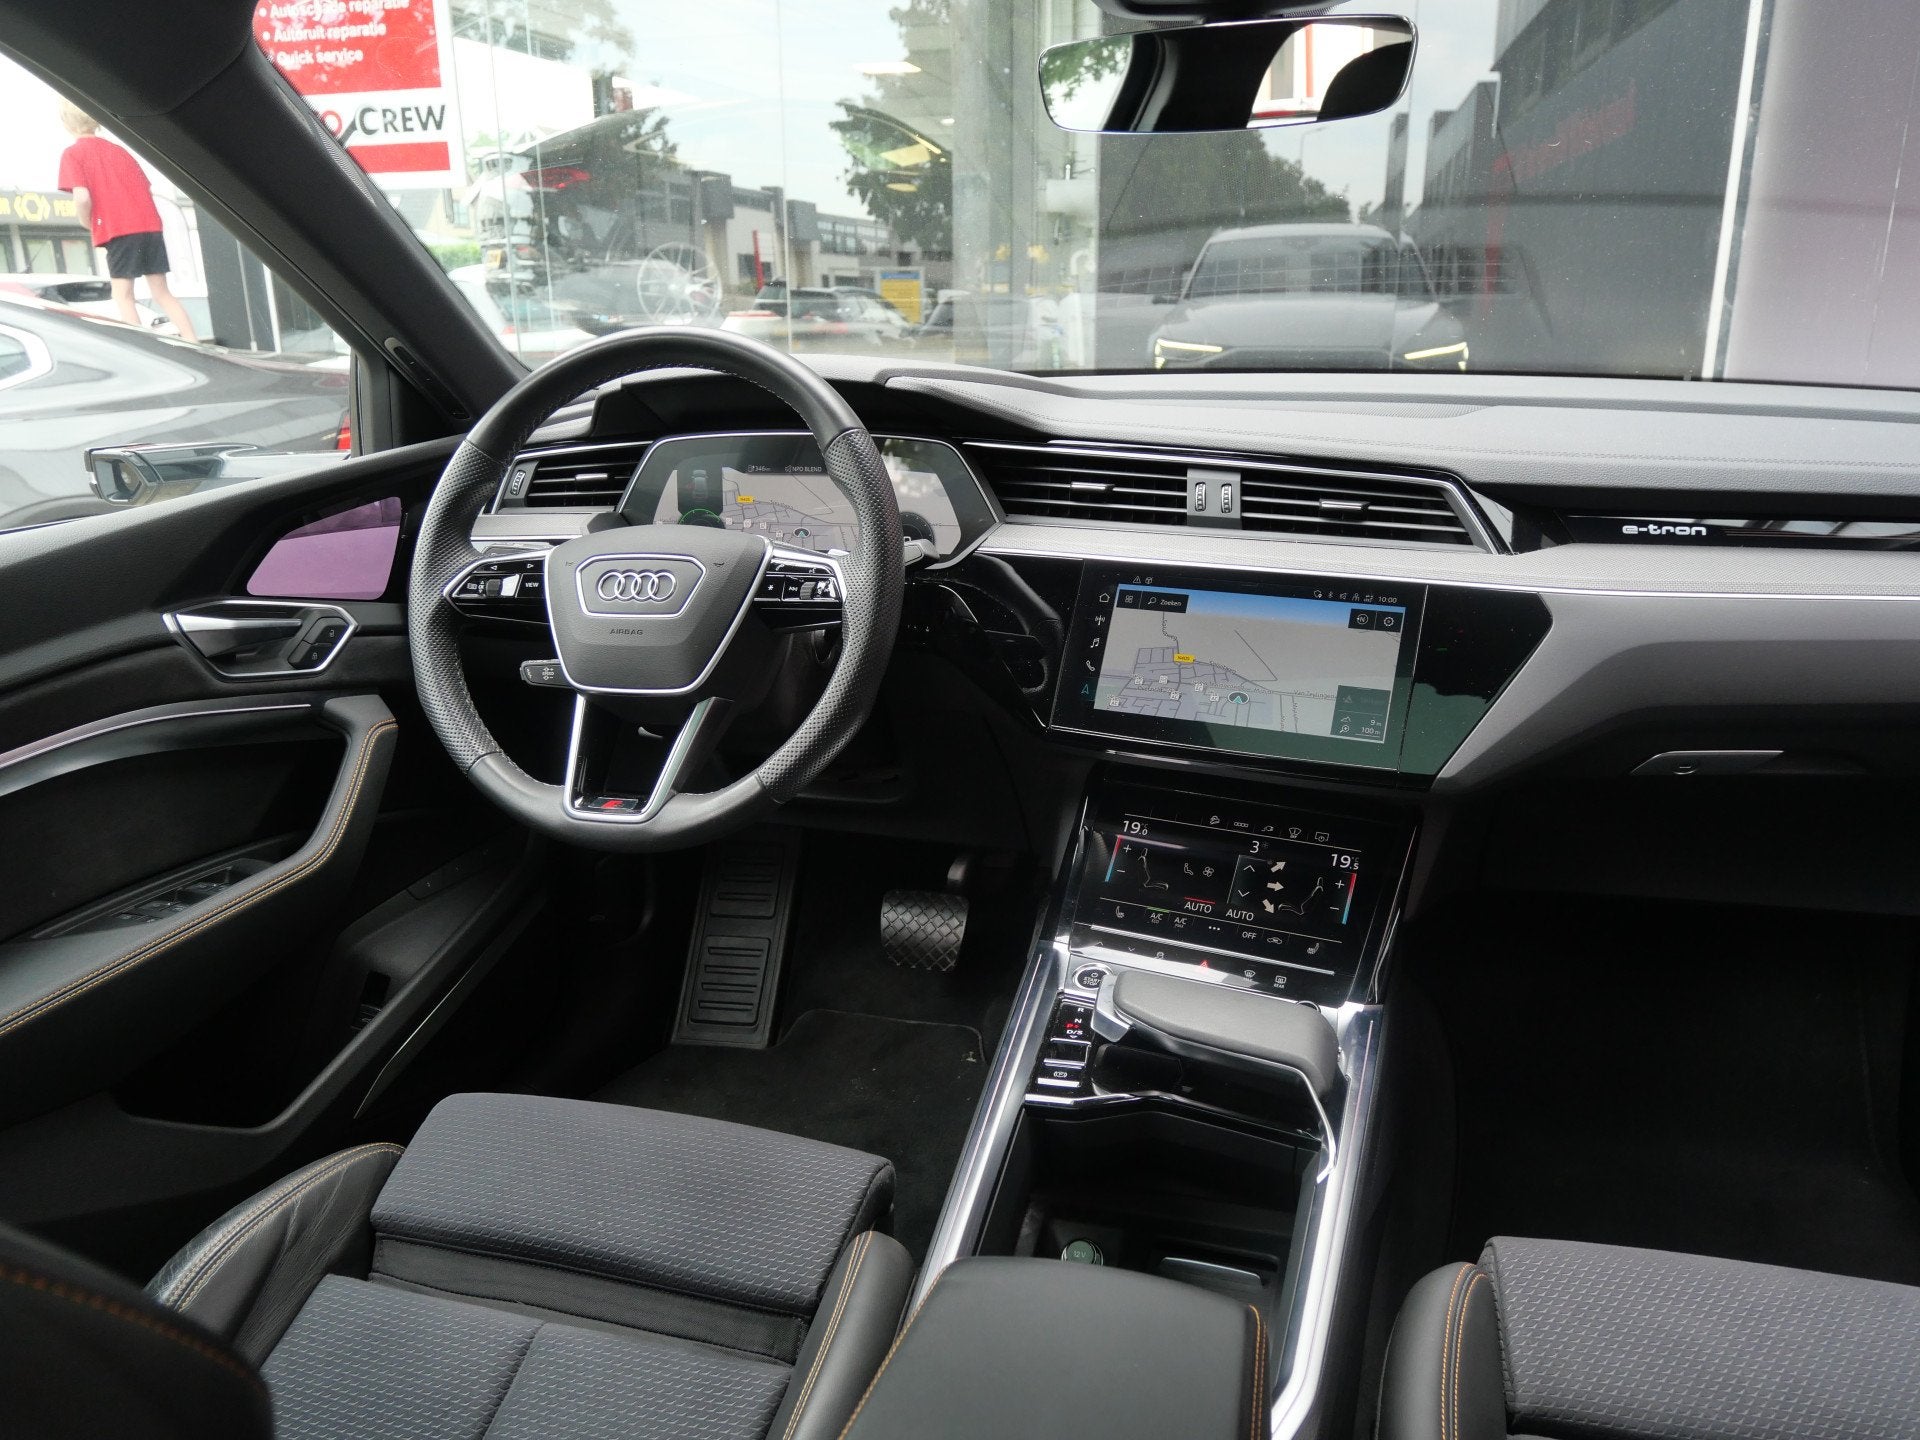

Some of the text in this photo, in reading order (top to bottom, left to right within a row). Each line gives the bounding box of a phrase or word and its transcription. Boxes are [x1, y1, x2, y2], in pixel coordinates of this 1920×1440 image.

[327, 23, 386, 41] reparatie
[276, 48, 364, 66] Quick service
[357, 104, 446, 136] CREW
[1622, 524, 1707, 536] e-tron
[1160, 599, 1182, 607] Zoeken
[609, 628, 644, 636] AIRBAG
[1361, 726, 1375, 735] 100
[1249, 840, 1260, 854] 3
[1184, 901, 1213, 914] AUTO
[1150, 912, 1164, 921] A/C
[1225, 908, 1255, 921] AUTO
[1174, 917, 1188, 925] A/C
[1242, 931, 1257, 940] OFF
